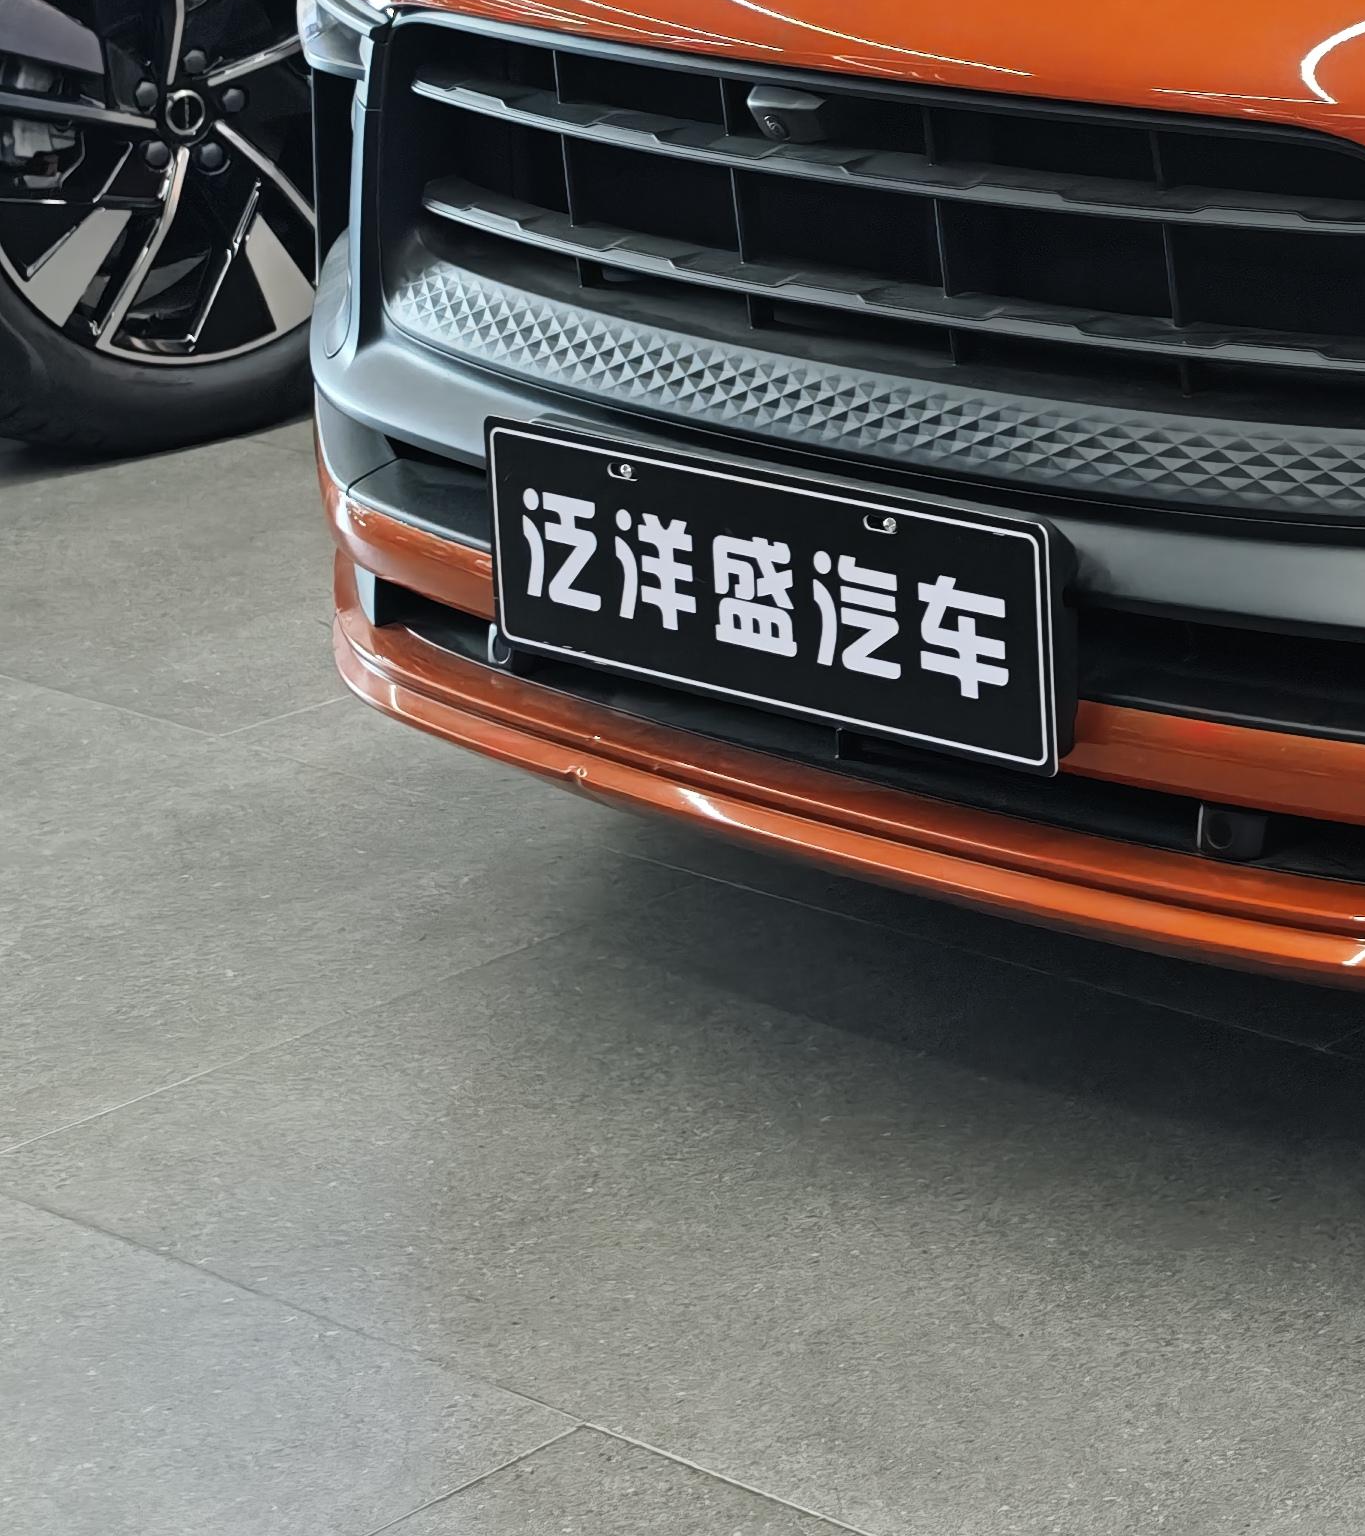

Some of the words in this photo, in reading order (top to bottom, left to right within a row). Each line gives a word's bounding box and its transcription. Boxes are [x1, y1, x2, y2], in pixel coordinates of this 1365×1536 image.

[522, 488, 1010, 700] 泛洋盛汽车
